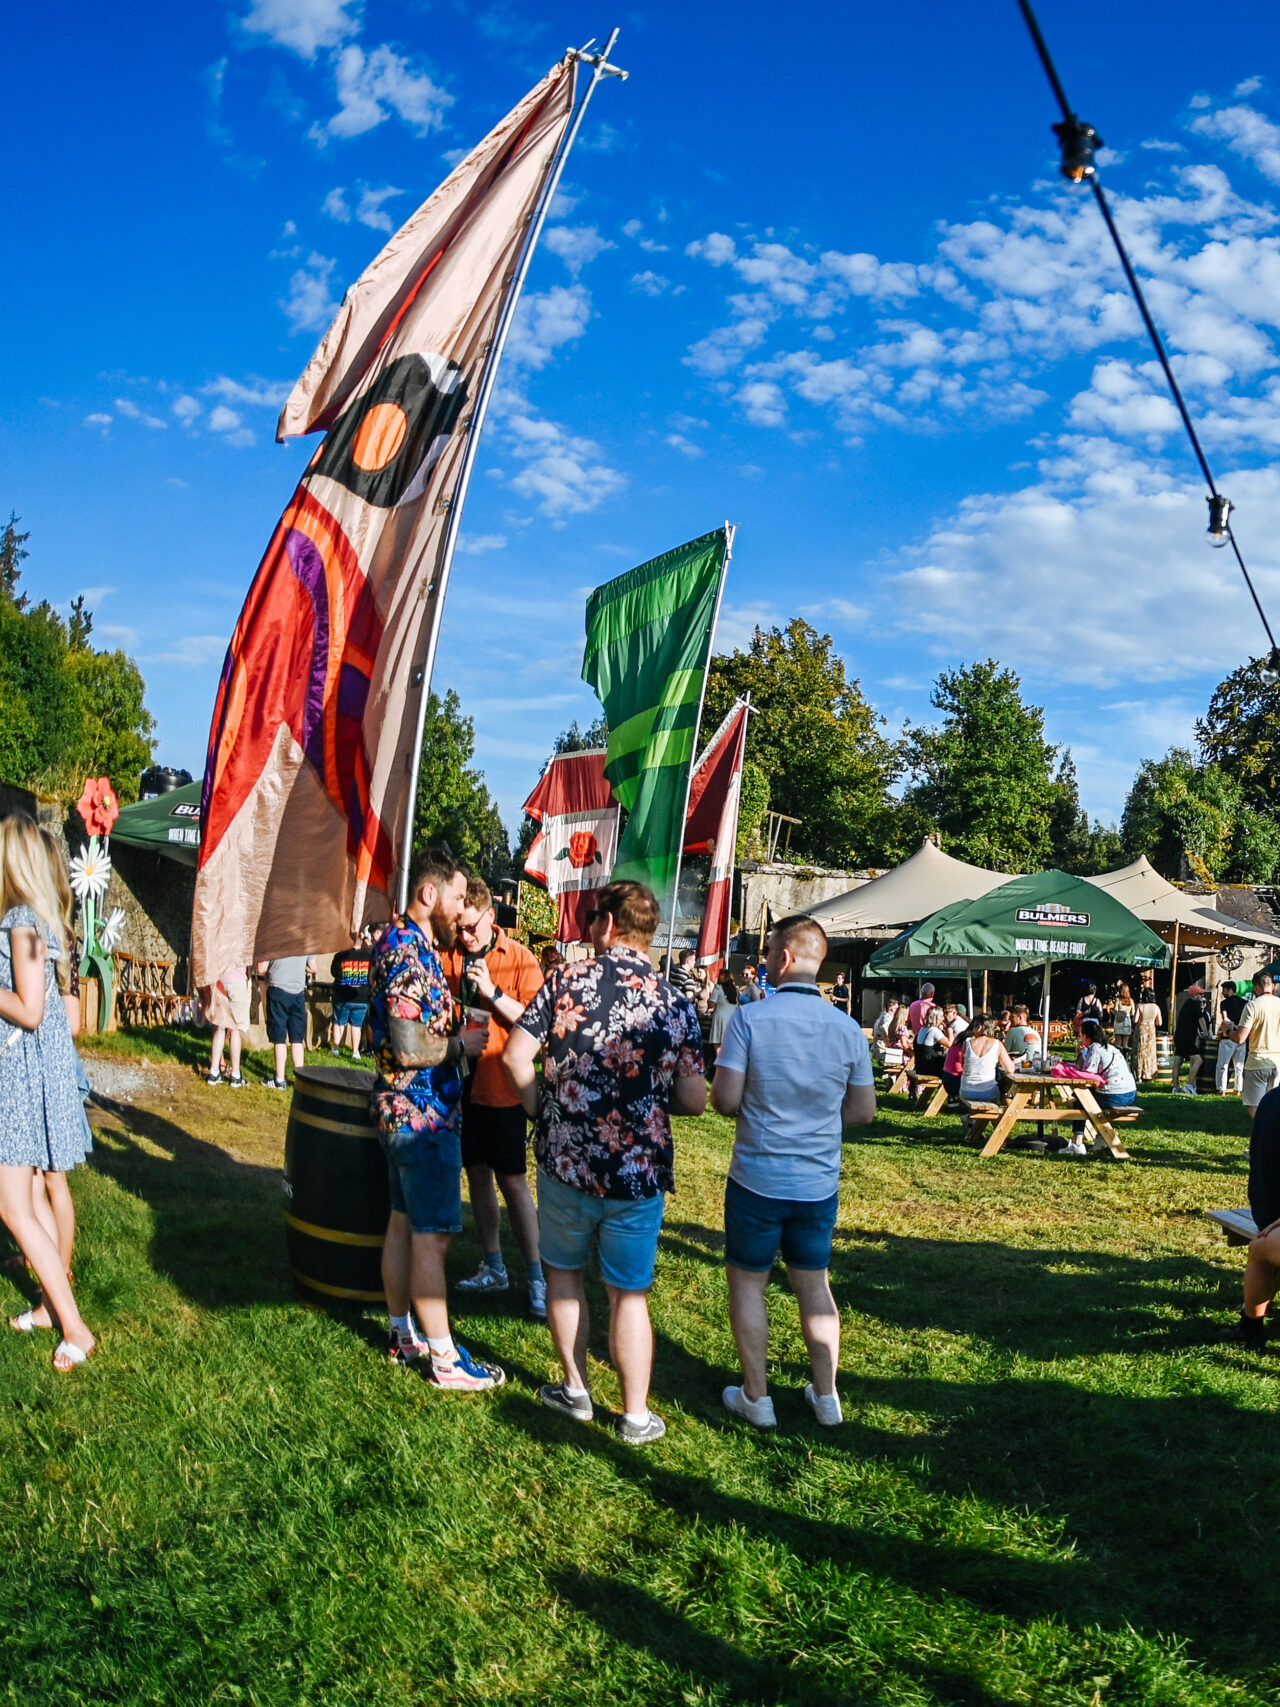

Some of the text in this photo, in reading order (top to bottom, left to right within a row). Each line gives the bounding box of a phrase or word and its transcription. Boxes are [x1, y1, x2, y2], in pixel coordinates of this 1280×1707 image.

[1018, 911, 1087, 924] BULMERS
[1015, 938, 1033, 951] WHEN
[1034, 939, 1049, 953] TIME
[1069, 942, 1086, 955] FRUIT
